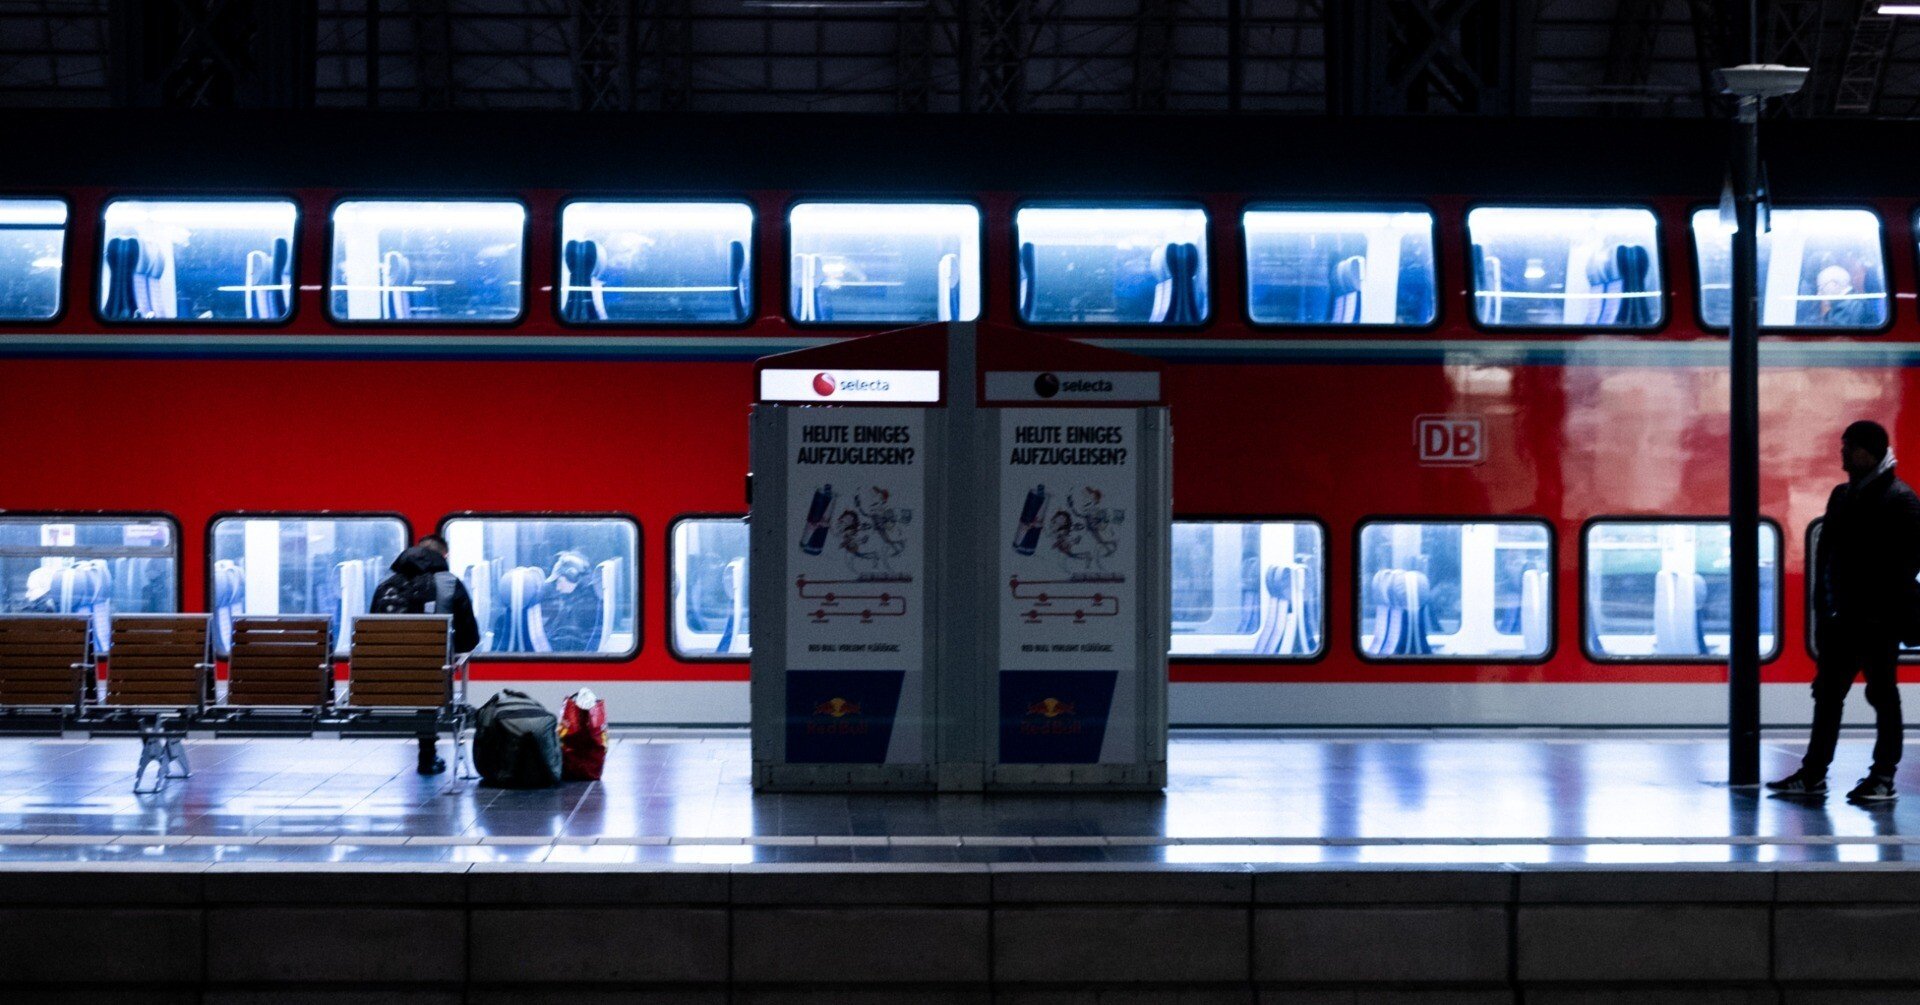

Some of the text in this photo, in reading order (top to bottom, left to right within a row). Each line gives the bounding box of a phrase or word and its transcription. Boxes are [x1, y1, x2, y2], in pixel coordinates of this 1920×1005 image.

[839, 378, 890, 391] selecta
[1062, 379, 1113, 393] selecta
[802, 426, 910, 443] HEUTE EINIGES
[1015, 426, 1122, 443] HEUTE EINIGES
[1423, 422, 1478, 458] DB
[797, 447, 915, 465] AUFZUGLEISEN?
[1010, 447, 1127, 465] AUFZUGLEISEN?
